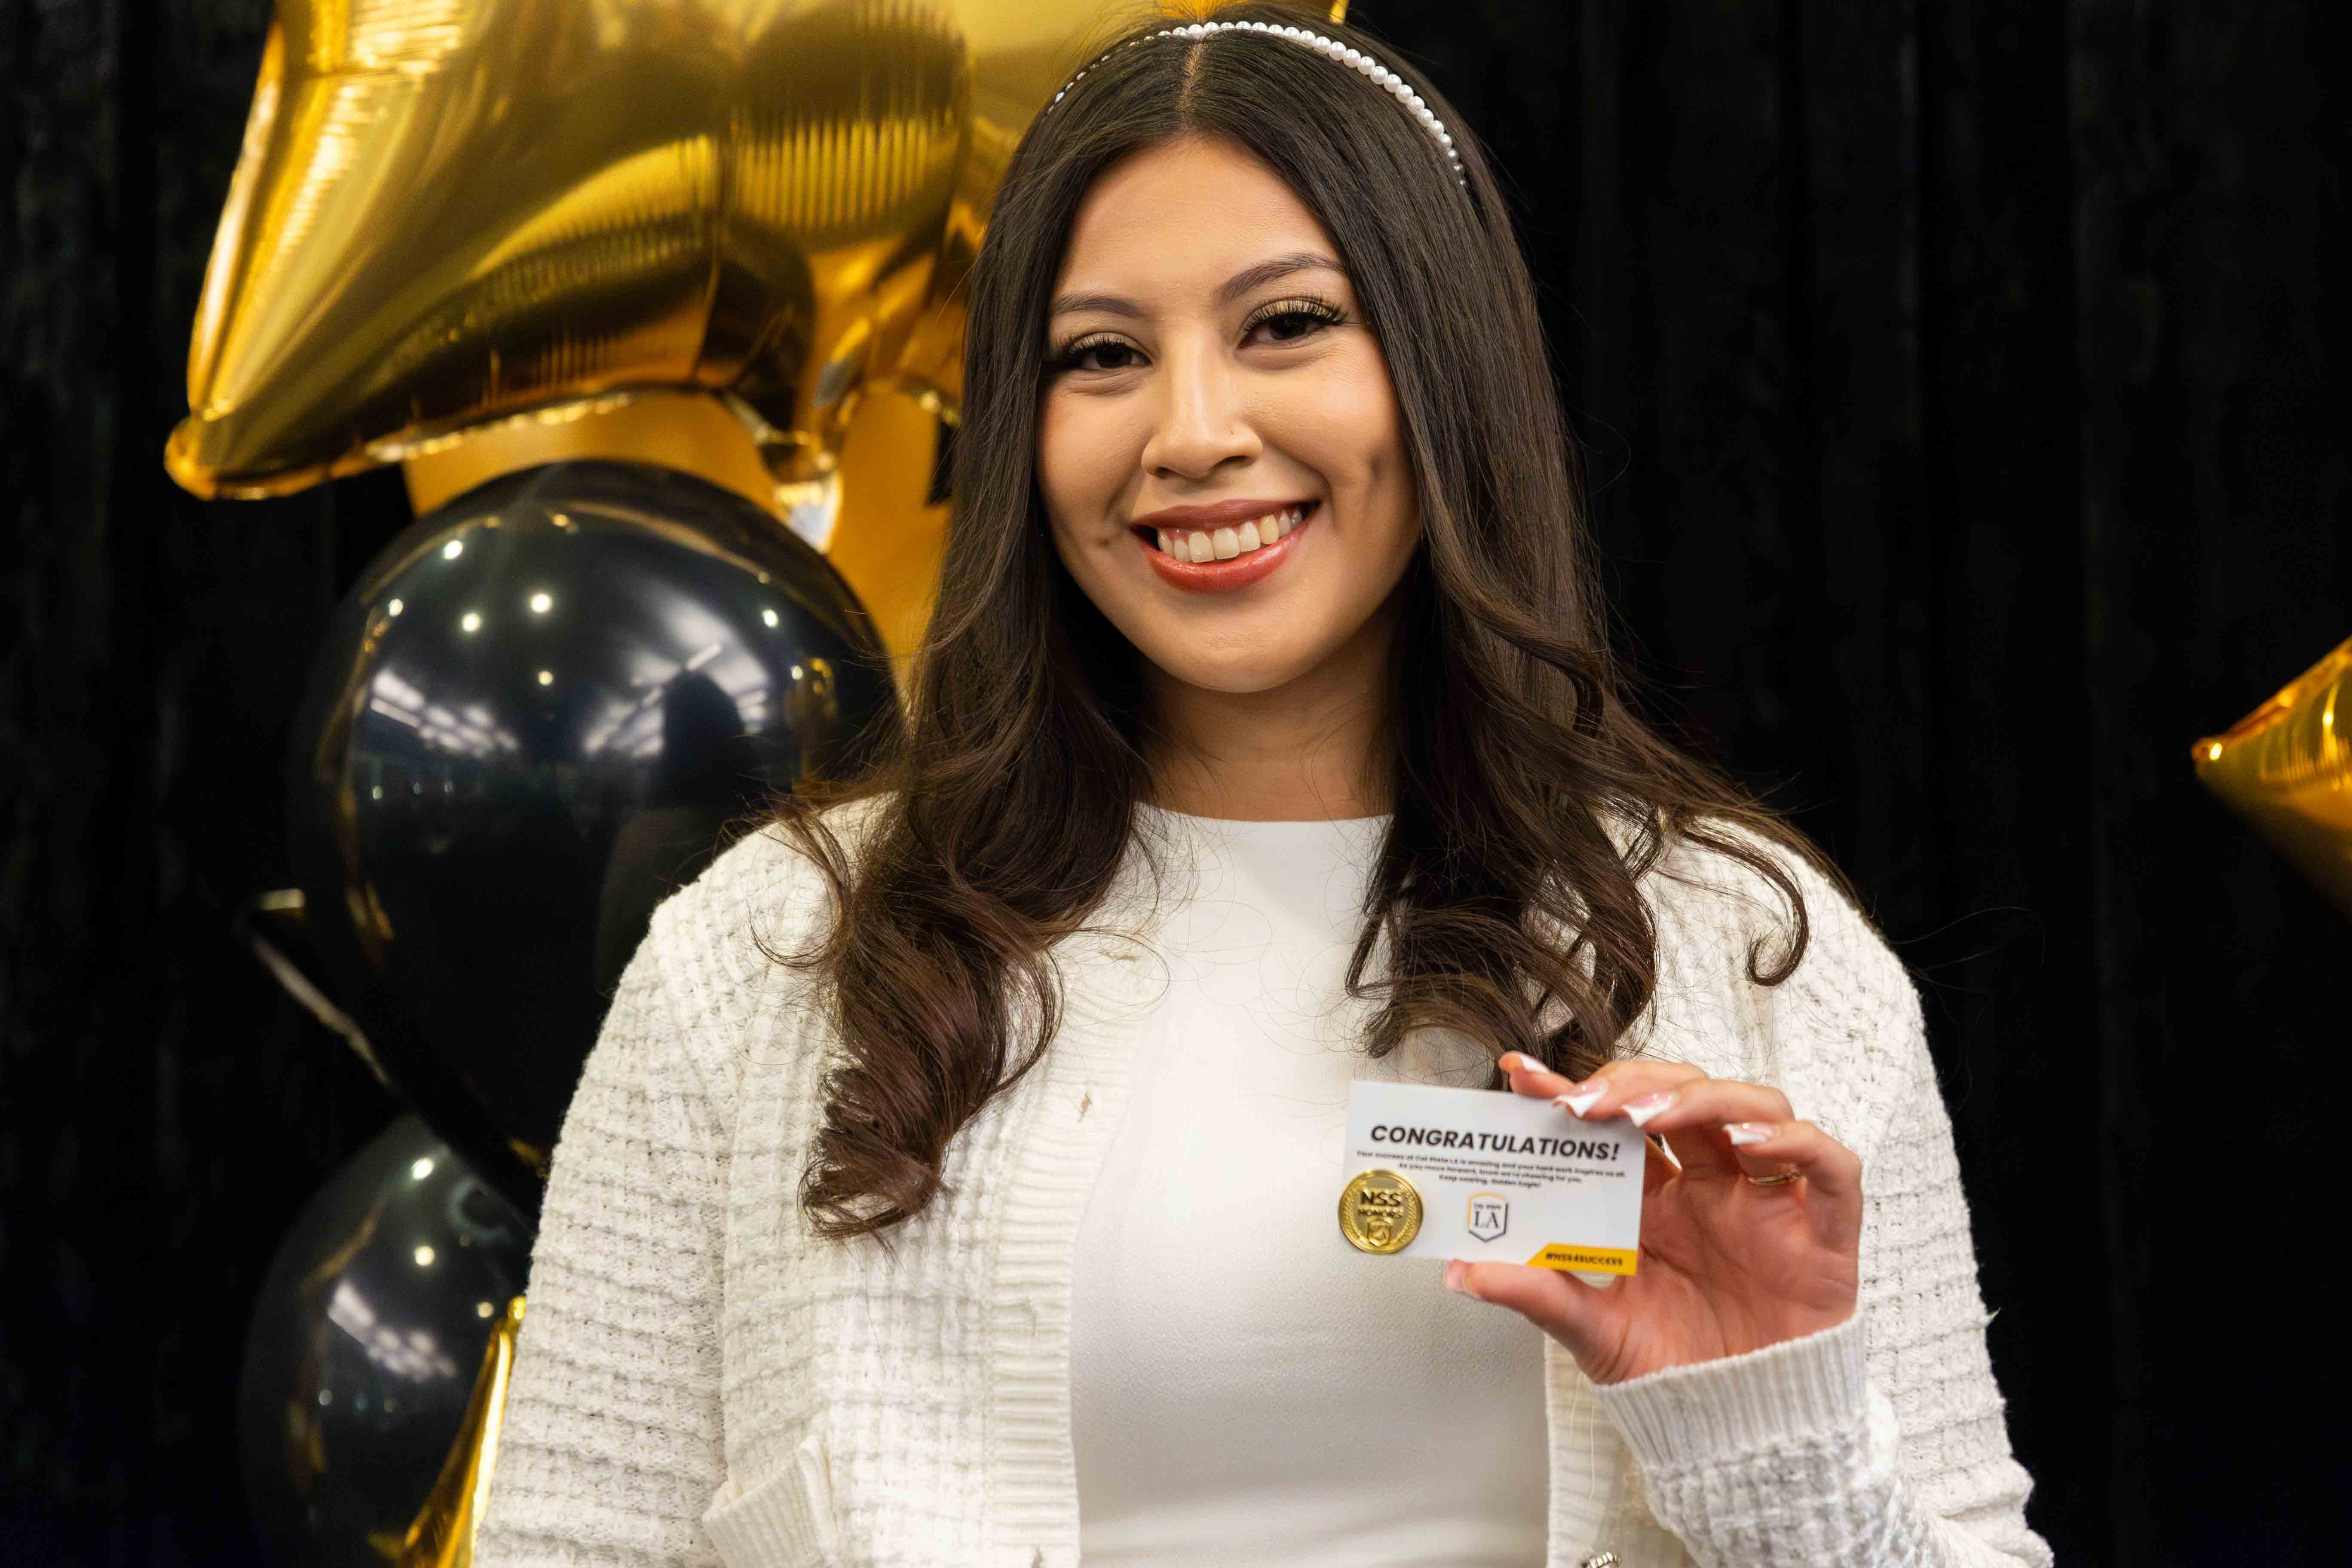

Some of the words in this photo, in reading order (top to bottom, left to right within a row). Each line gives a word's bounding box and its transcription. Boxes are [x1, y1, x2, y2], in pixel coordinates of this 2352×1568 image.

[1371, 1125, 1621, 1161] CONGRATULATIONS!
[1467, 1160, 1499, 1168] amazing
[1360, 1189, 1403, 1206] NSS
[1475, 1211, 1500, 1228] LA
[1546, 1252, 1623, 1266] #NSS4SUCCESS
